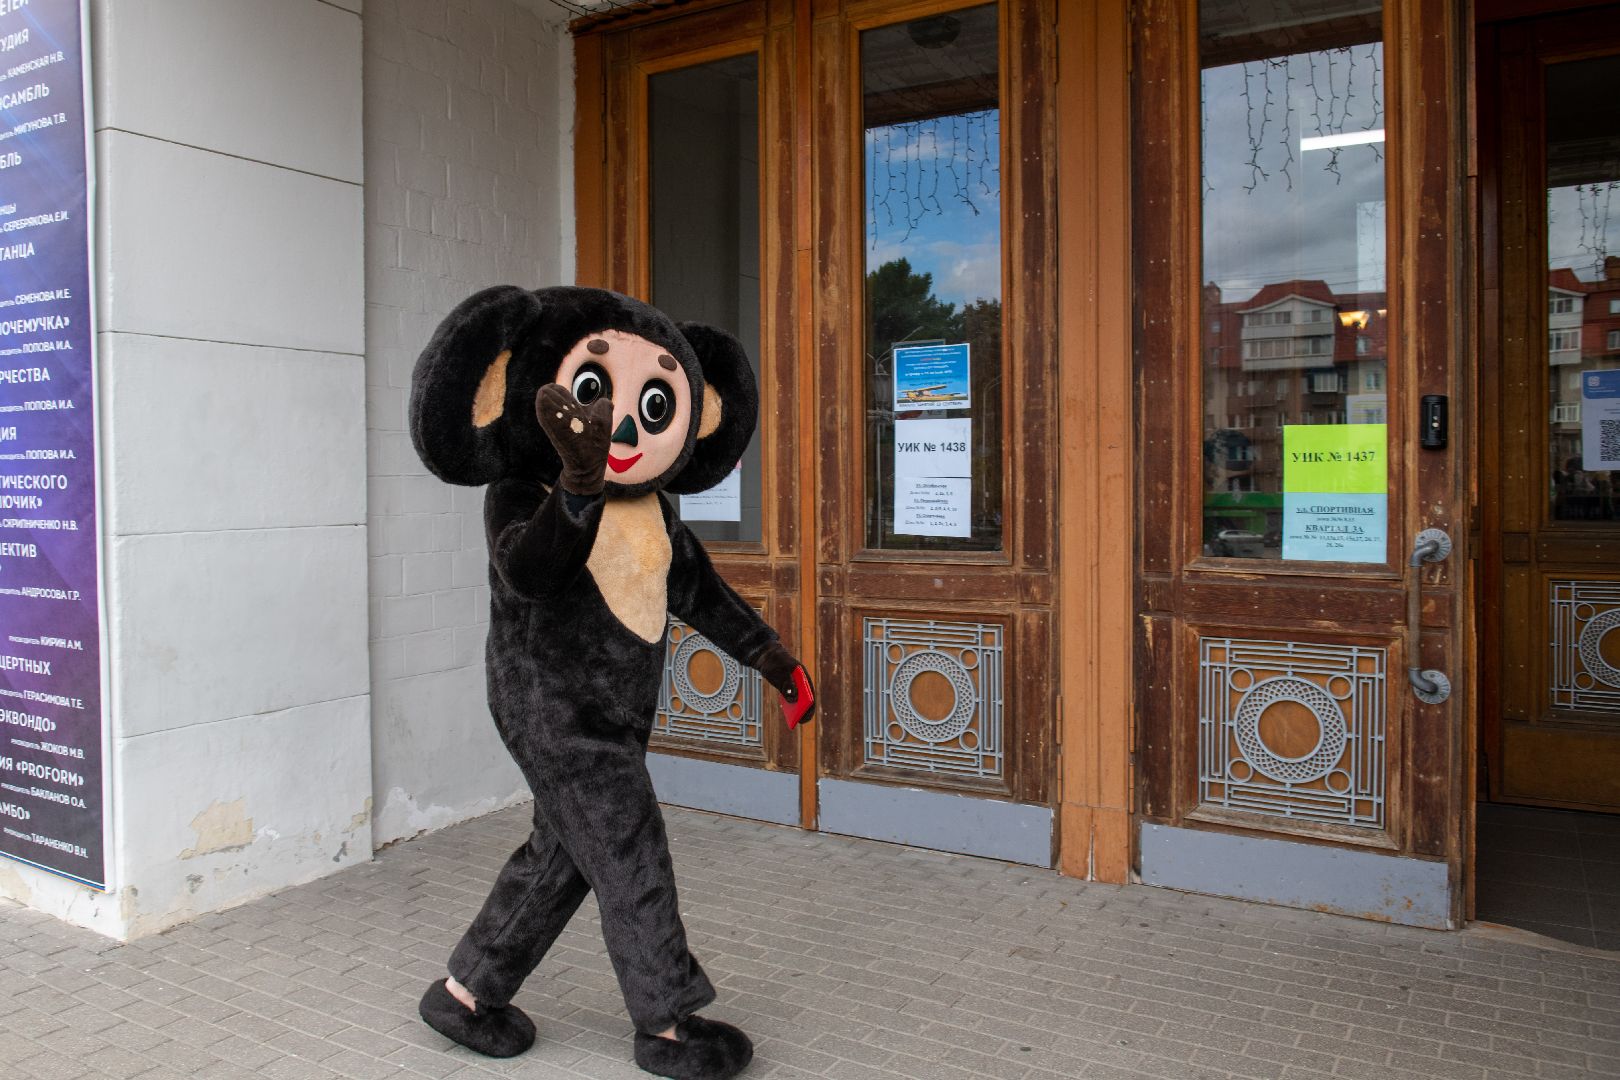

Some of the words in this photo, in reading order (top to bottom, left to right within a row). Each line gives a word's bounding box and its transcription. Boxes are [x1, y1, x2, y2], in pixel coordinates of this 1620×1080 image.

[0, 28, 29, 52] УДИЯ
[0, 315, 71, 336] ОЧЕМУЧКА»
[23, 341, 55, 354] ПОПОВА
[55, 340, 73, 350] И.А.
[24, 400, 57, 411] ПОПОВА
[57, 399, 76, 409] И.А.
[897, 442, 921, 453] УИК
[923, 442, 937, 452] №
[940, 442, 966, 453] 1438
[25, 449, 59, 460] ПОПОВА
[59, 449, 77, 459] И.А.
[1291, 452, 1324, 463] УИК
[1327, 451, 1342, 462] №
[1346, 451, 1375, 462] 1437
[61, 520, 79, 531] Н.В.
[66, 639, 84, 651] А.М.
[15, 760, 85, 787] «PROFORM»
[70, 796, 88, 809] О.А.
[74, 845, 89, 859] В.Н.
